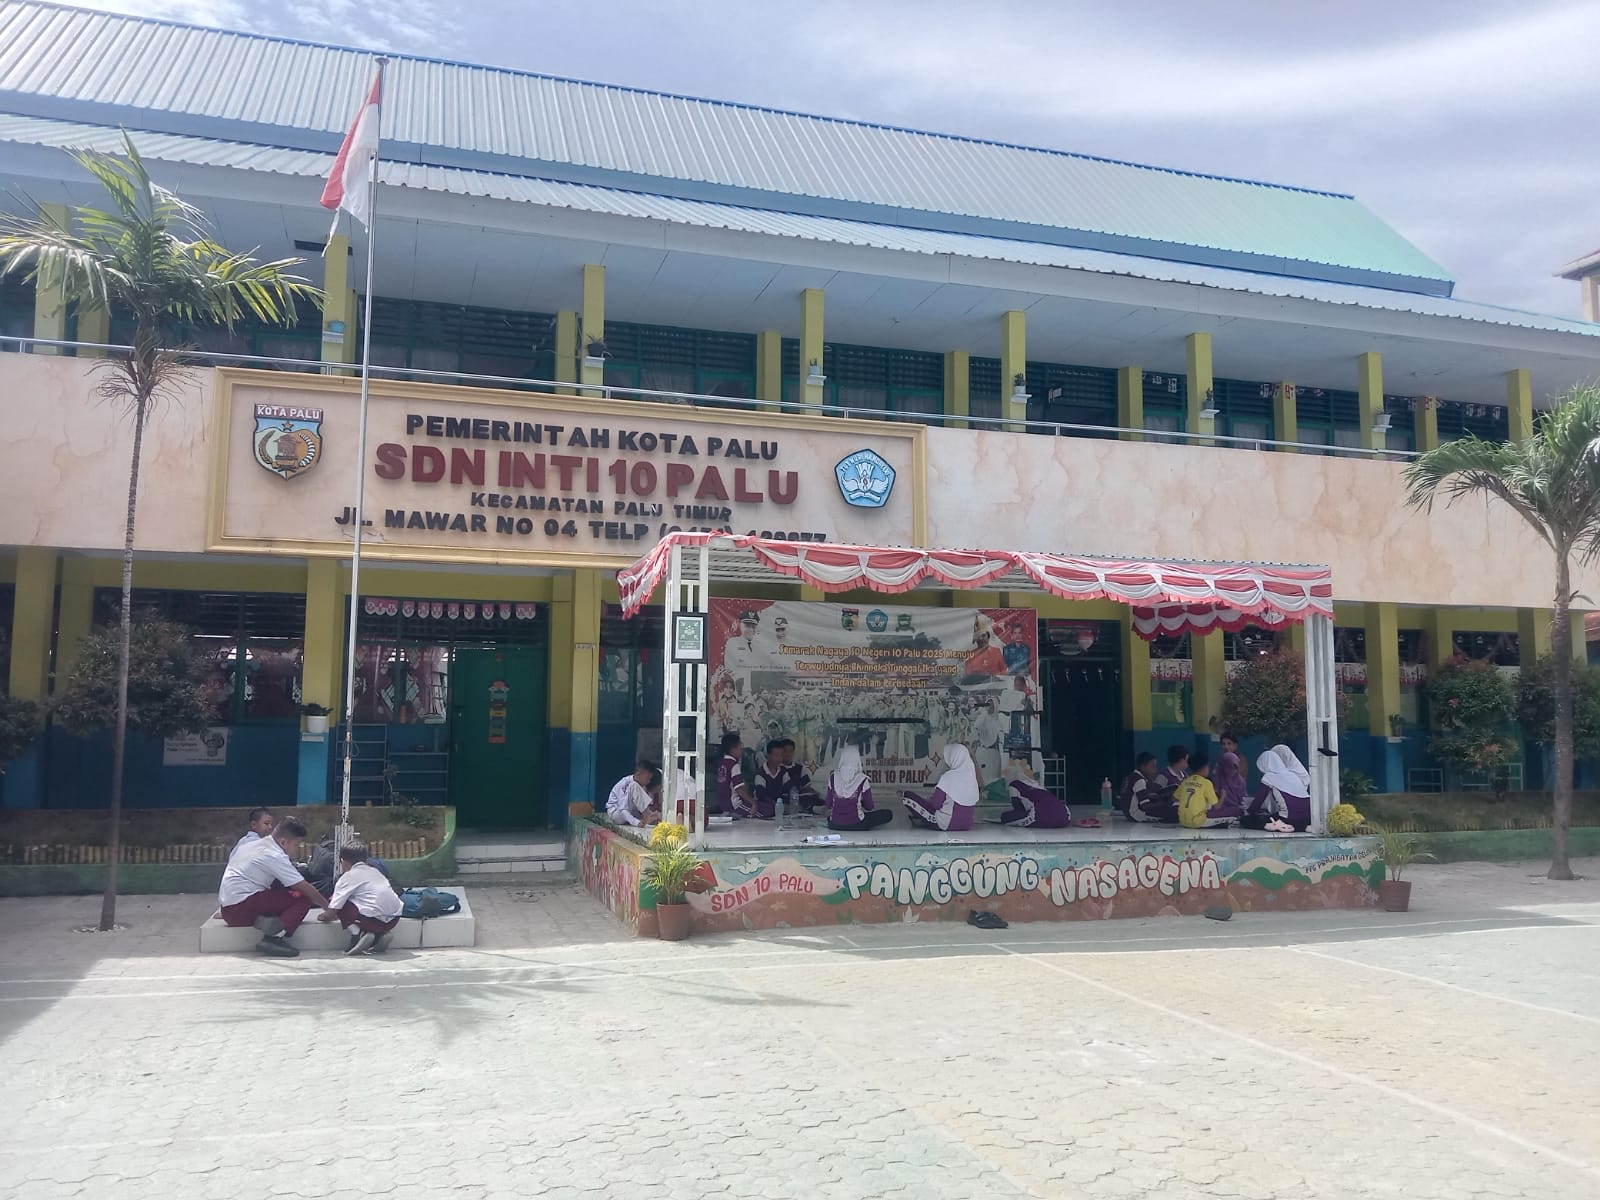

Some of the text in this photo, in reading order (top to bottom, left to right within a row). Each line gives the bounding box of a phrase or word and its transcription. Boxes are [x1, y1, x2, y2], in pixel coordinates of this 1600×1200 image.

[257, 404, 320, 420] KOTA PALU
[406, 414, 779, 461] PEMERINTAH KOTA PALU
[375, 443, 799, 505] SDN INTI 10 PALU
[471, 491, 733, 523] KECAMATAN PALU TIMUR
[384, 509, 488, 533] MAWAR
[496, 515, 534, 535] NO
[544, 518, 578, 537] 04
[588, 521, 650, 541] TELP
[778, 644, 816, 656] Semarak
[851, 647, 861, 656] SD
[863, 647, 890, 659] Negeri
[892, 648, 902, 658] 10
[903, 648, 921, 659] Palu
[922, 649, 945, 659] 2025
[945, 649, 975, 661] Menuju
[795, 661, 849, 674] Terwujudnya
[889, 663, 920, 675] Tunggal
[857, 678, 881, 688] dalam
[883, 678, 927, 689] Perbedaan
[885, 769, 897, 784] 10
[899, 769, 925, 784] PALU
[1185, 787, 1196, 809] 7
[710, 873, 814, 914] SDN 10 PALU
[845, 854, 1222, 907] PANGGUNG NASAGENA
